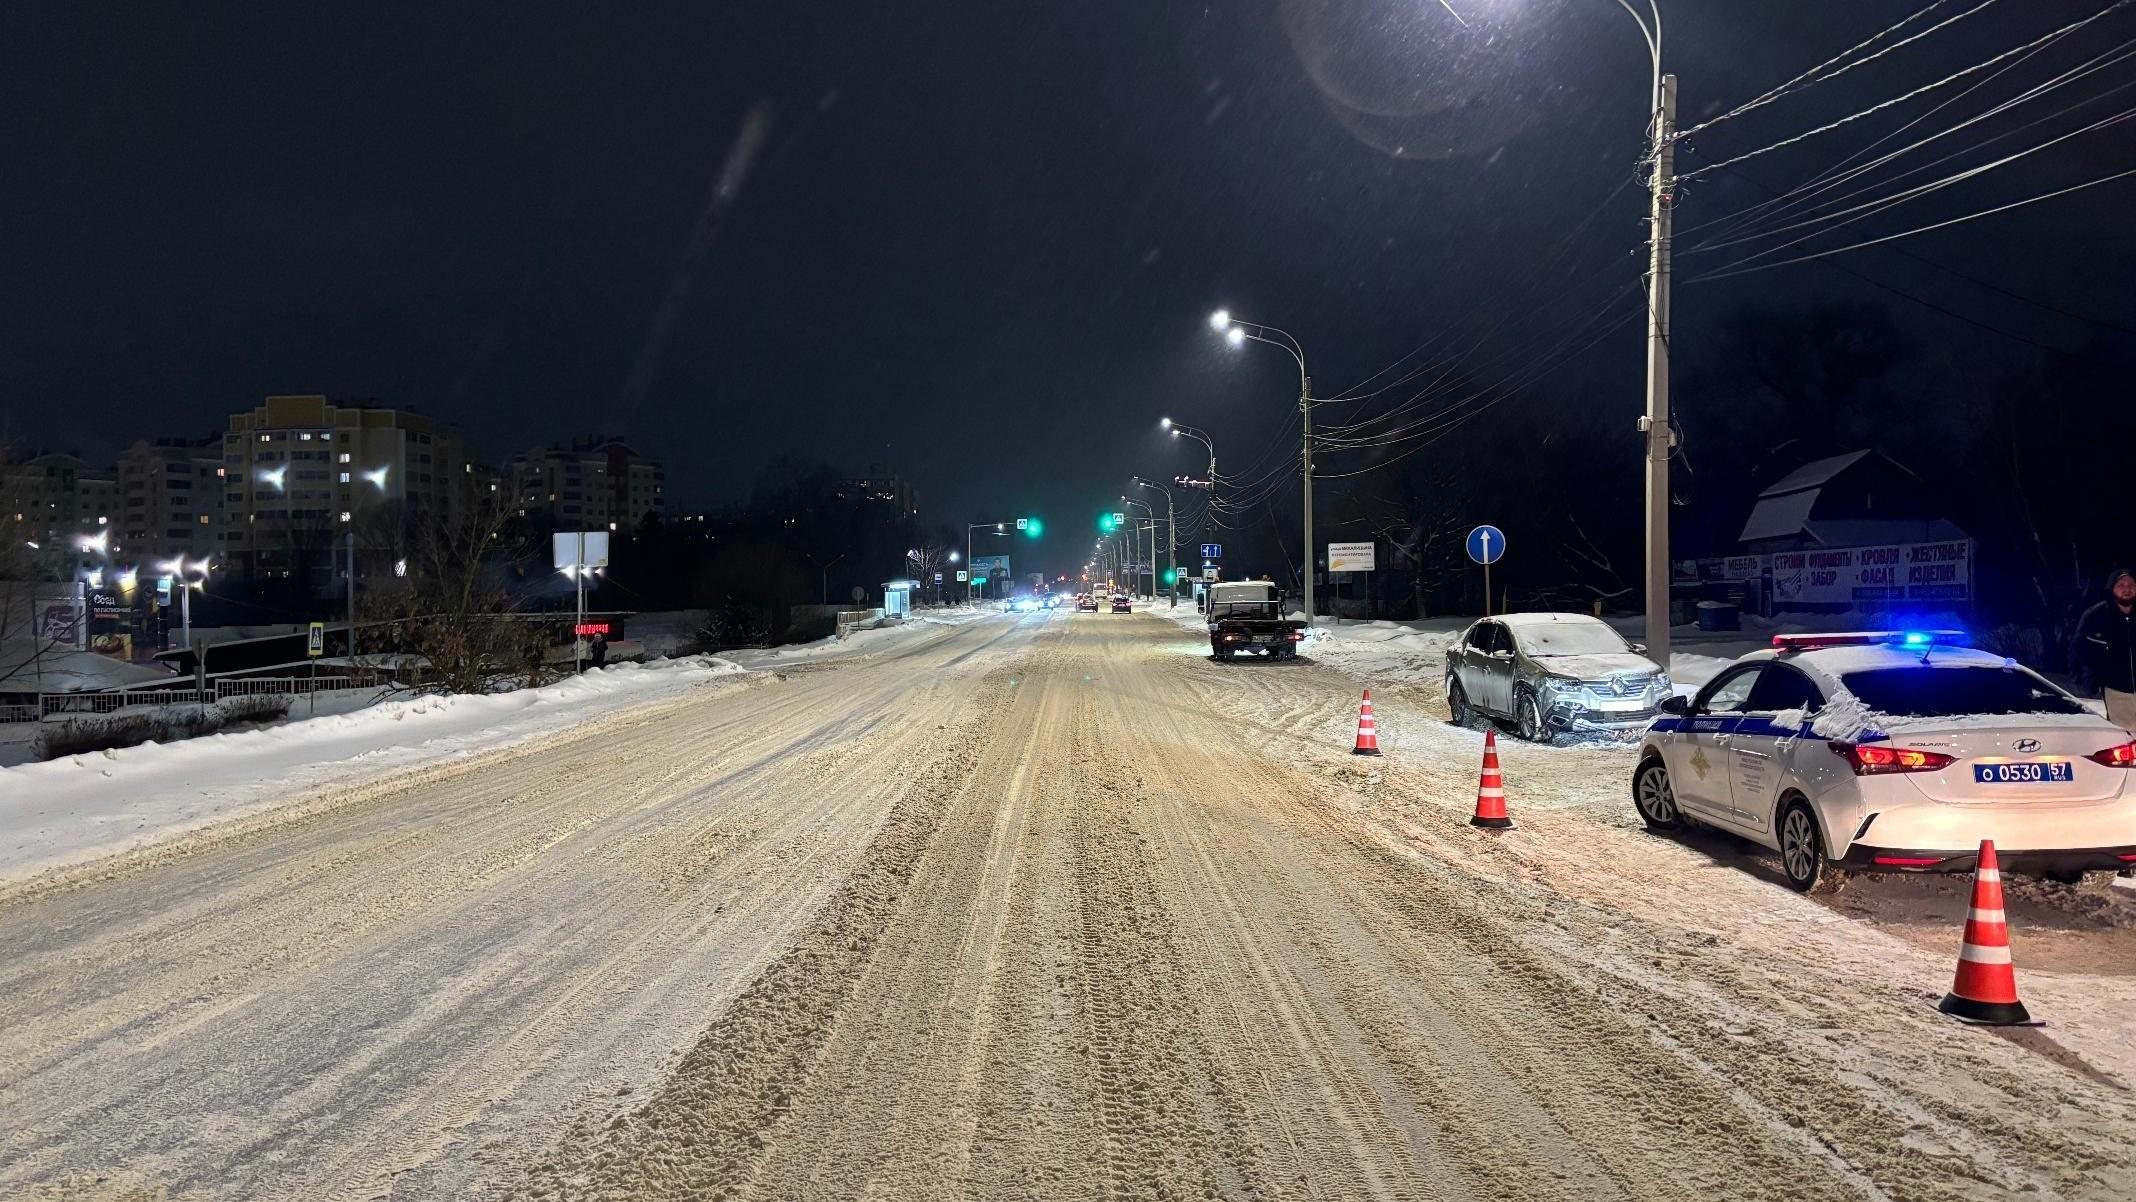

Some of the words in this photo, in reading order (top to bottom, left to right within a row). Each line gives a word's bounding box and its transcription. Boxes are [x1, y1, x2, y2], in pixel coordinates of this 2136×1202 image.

[1860, 548, 1900, 566] КРОВЛЯ
[1910, 543, 1966, 563] ЖЕСТЯНЫЕ
[1728, 557, 1758, 571] МЕБЕЛЬ
[1811, 571, 1837, 586] ЗАБОР
[1999, 764, 2041, 781] 0530
[2051, 763, 2066, 775] 57
